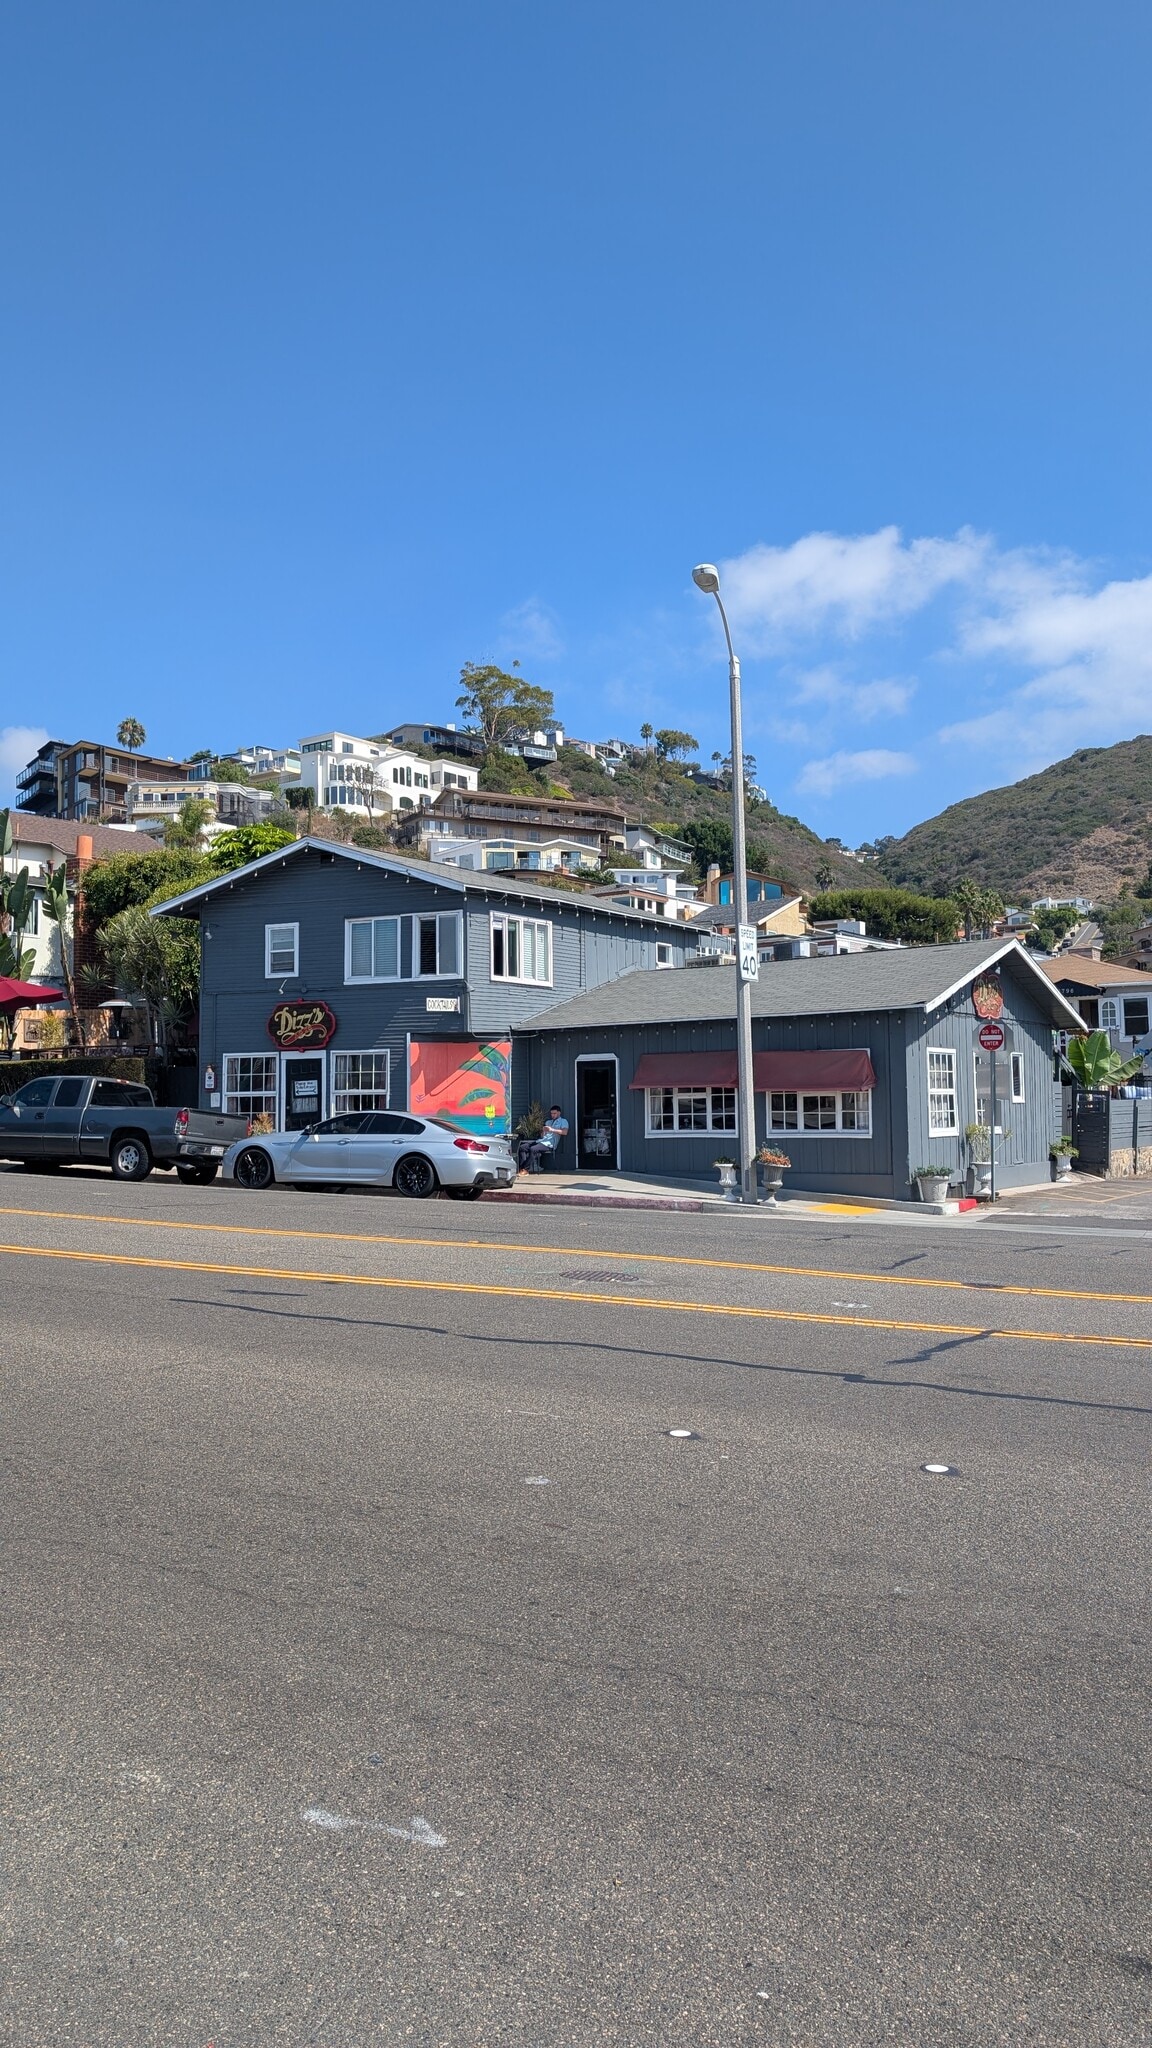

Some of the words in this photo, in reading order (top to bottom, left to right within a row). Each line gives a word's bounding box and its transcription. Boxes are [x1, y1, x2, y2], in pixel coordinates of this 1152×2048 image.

[741, 929, 754, 939] SPEED
[743, 941, 754, 951] LIMIT
[743, 955, 756, 975] 40
[274, 1006, 325, 1036] Dizz's
